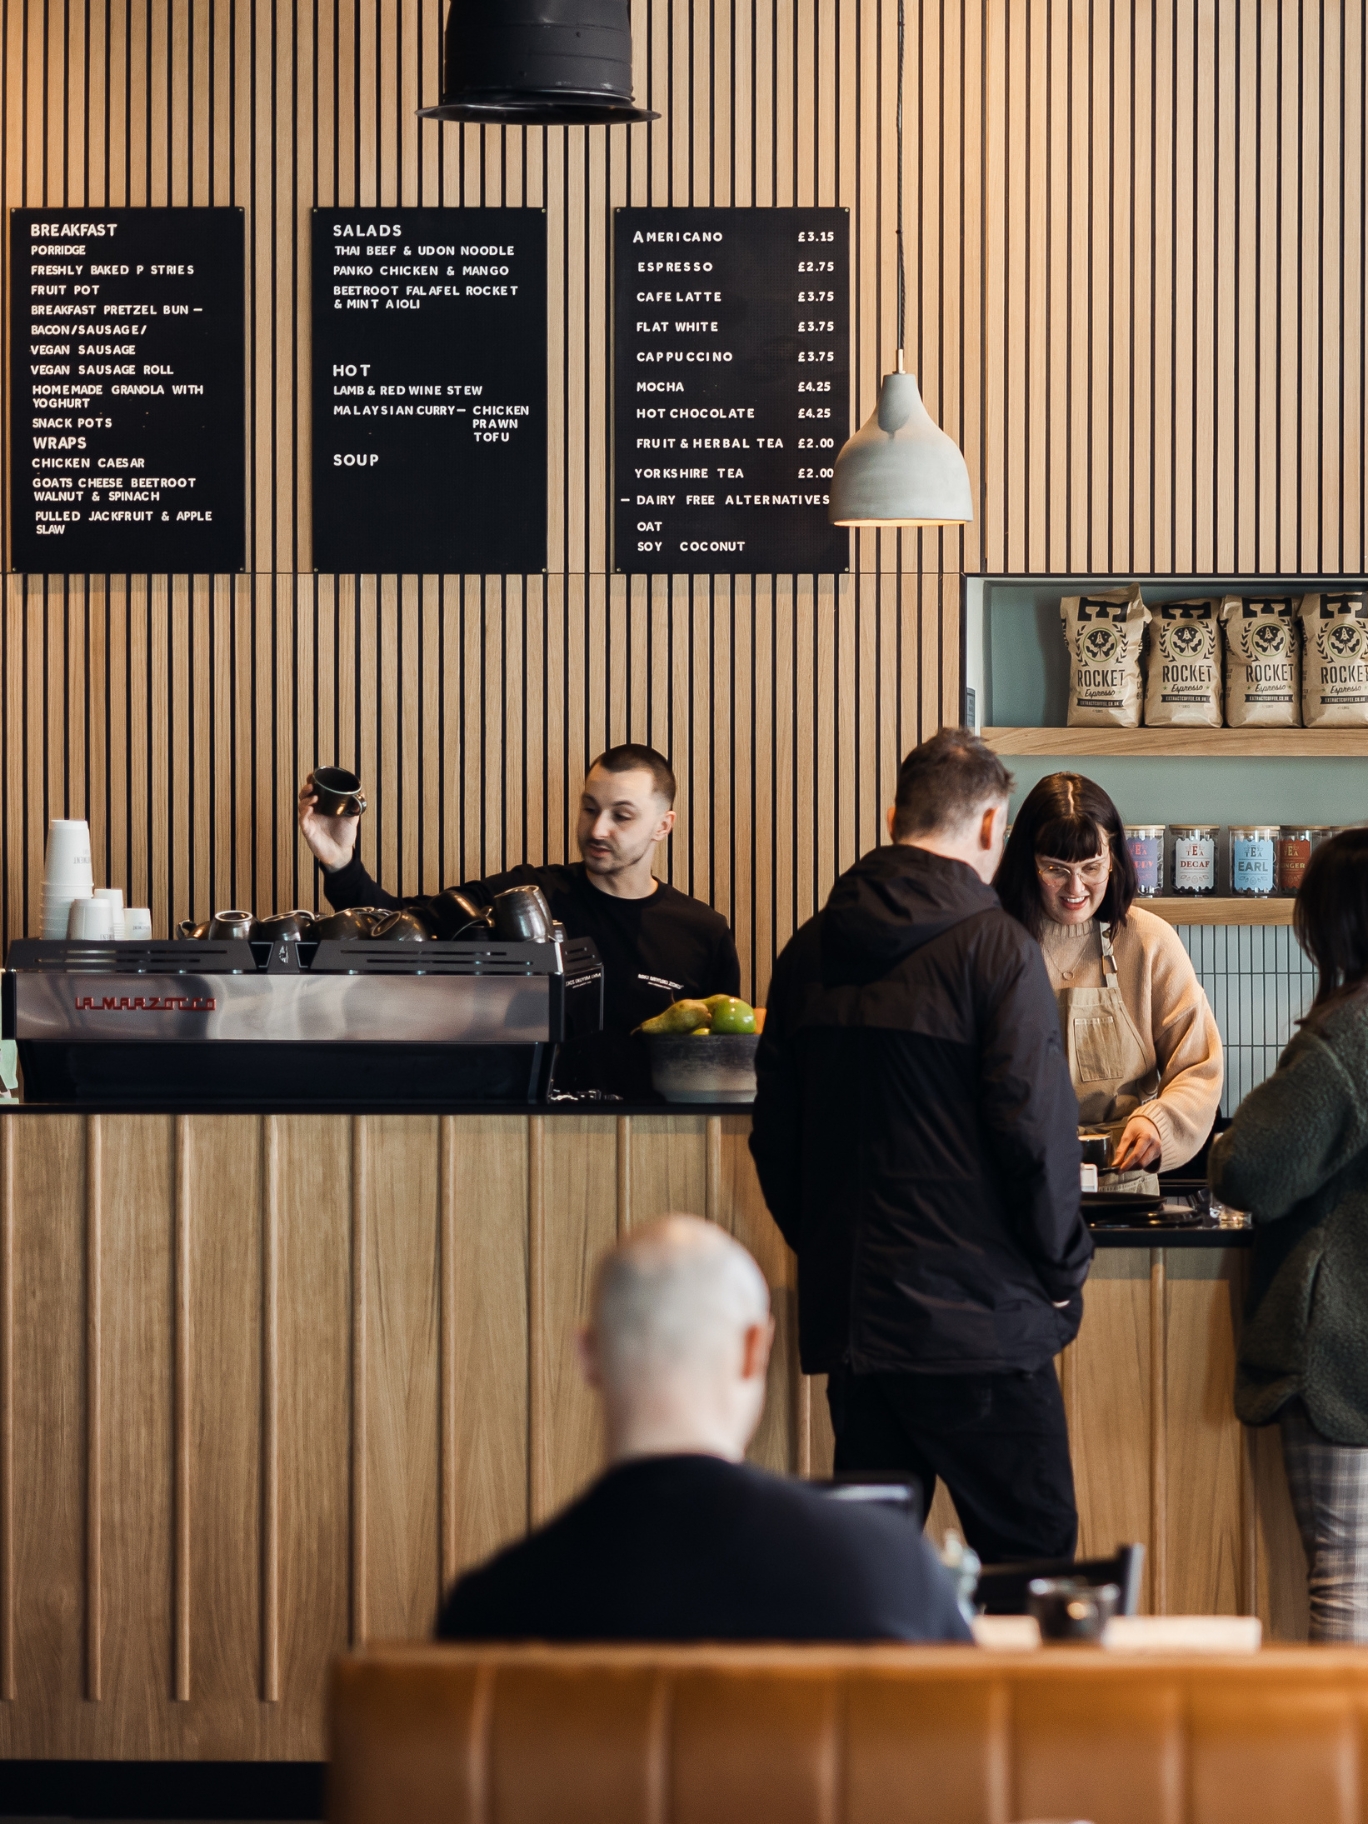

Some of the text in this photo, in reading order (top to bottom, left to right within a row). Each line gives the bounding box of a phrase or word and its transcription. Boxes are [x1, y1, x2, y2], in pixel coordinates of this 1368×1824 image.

[31, 224, 117, 236] BREAKFAST
[333, 225, 401, 237] SALADS
[633, 231, 834, 243] AMERICANO £3.15
[31, 245, 85, 255] PORRIDGE
[335, 246, 514, 255] THAI BEEF & UDON NOODLE
[31, 265, 83, 275] FRESHLY
[91, 265, 129, 275] BAKED
[334, 266, 509, 276] PANKO CHICKEN & MANGO
[638, 262, 834, 272] ESPRESSO £2.75
[31, 285, 99, 295] FRUIT POT
[334, 286, 518, 295] BEETROOT FALAFEL ROCKET
[637, 292, 834, 302] CAFE LATTE £3.75
[334, 299, 420, 309] & MINT AIOLI
[31, 305, 188, 315] BREAKFAST PRETZEL BUN
[31, 325, 147, 335] BACON/SAUSAGE/
[637, 321, 834, 332] FLAT WHITE £3.75
[31, 345, 135, 355] VEGAN SAUSAGE
[637, 352, 834, 362] CAPPUCCINO £3.75
[31, 365, 174, 375] VEGAN SAUSAGE ROLL
[333, 365, 370, 376] HOT
[33, 385, 203, 395] HOMEMADE GRANOLA WITH
[334, 386, 482, 395] LAMB & RED WINE STEW
[637, 382, 830, 392] MOCHA £4.25
[33, 398, 90, 408] YOGHURT
[334, 406, 413, 415] MALAYSIAN
[473, 406, 529, 415] CHICKEN
[637, 408, 830, 418] HOT CHOCOLATE £4.25
[33, 418, 112, 428] SNACK POTS
[473, 419, 518, 428] PRAWN
[474, 432, 509, 442] TOFU
[33, 437, 86, 449] WRAPS
[637, 438, 834, 448] FRUIT & HERBAL TEA £2.00
[32, 458, 144, 468] CHICKEN CAESAR
[334, 454, 378, 466] SOUP
[635, 468, 834, 478] YORKSHIRE TEA £2.00
[33, 478, 196, 488] GOATS CHEESE BEETROOT
[34, 491, 159, 501] WALNUT & SPINACH
[637, 495, 829, 505] DAIRY FREE ALTERNATIVES
[36, 511, 212, 521] PULLED JACKFRUIT & APPLE
[36, 525, 65, 534] SLAW
[637, 522, 662, 531] OAT
[638, 542, 745, 551] SOY COCONUT
[1078, 669, 1125, 687] ROCKET
[1162, 664, 1212, 682] ROCKET
[1246, 664, 1294, 682] ROCKET
[1321, 664, 1368, 684] ROCKET
[1085, 688, 1116, 698] Espresso
[1171, 684, 1204, 693] Espresso
[1255, 683, 1287, 693] Espresso
[1330, 685, 1362, 695] Espresso
[1187, 845, 1205, 856] TEA
[1245, 846, 1263, 857] TEA
[1238, 861, 1268, 872] EARL
